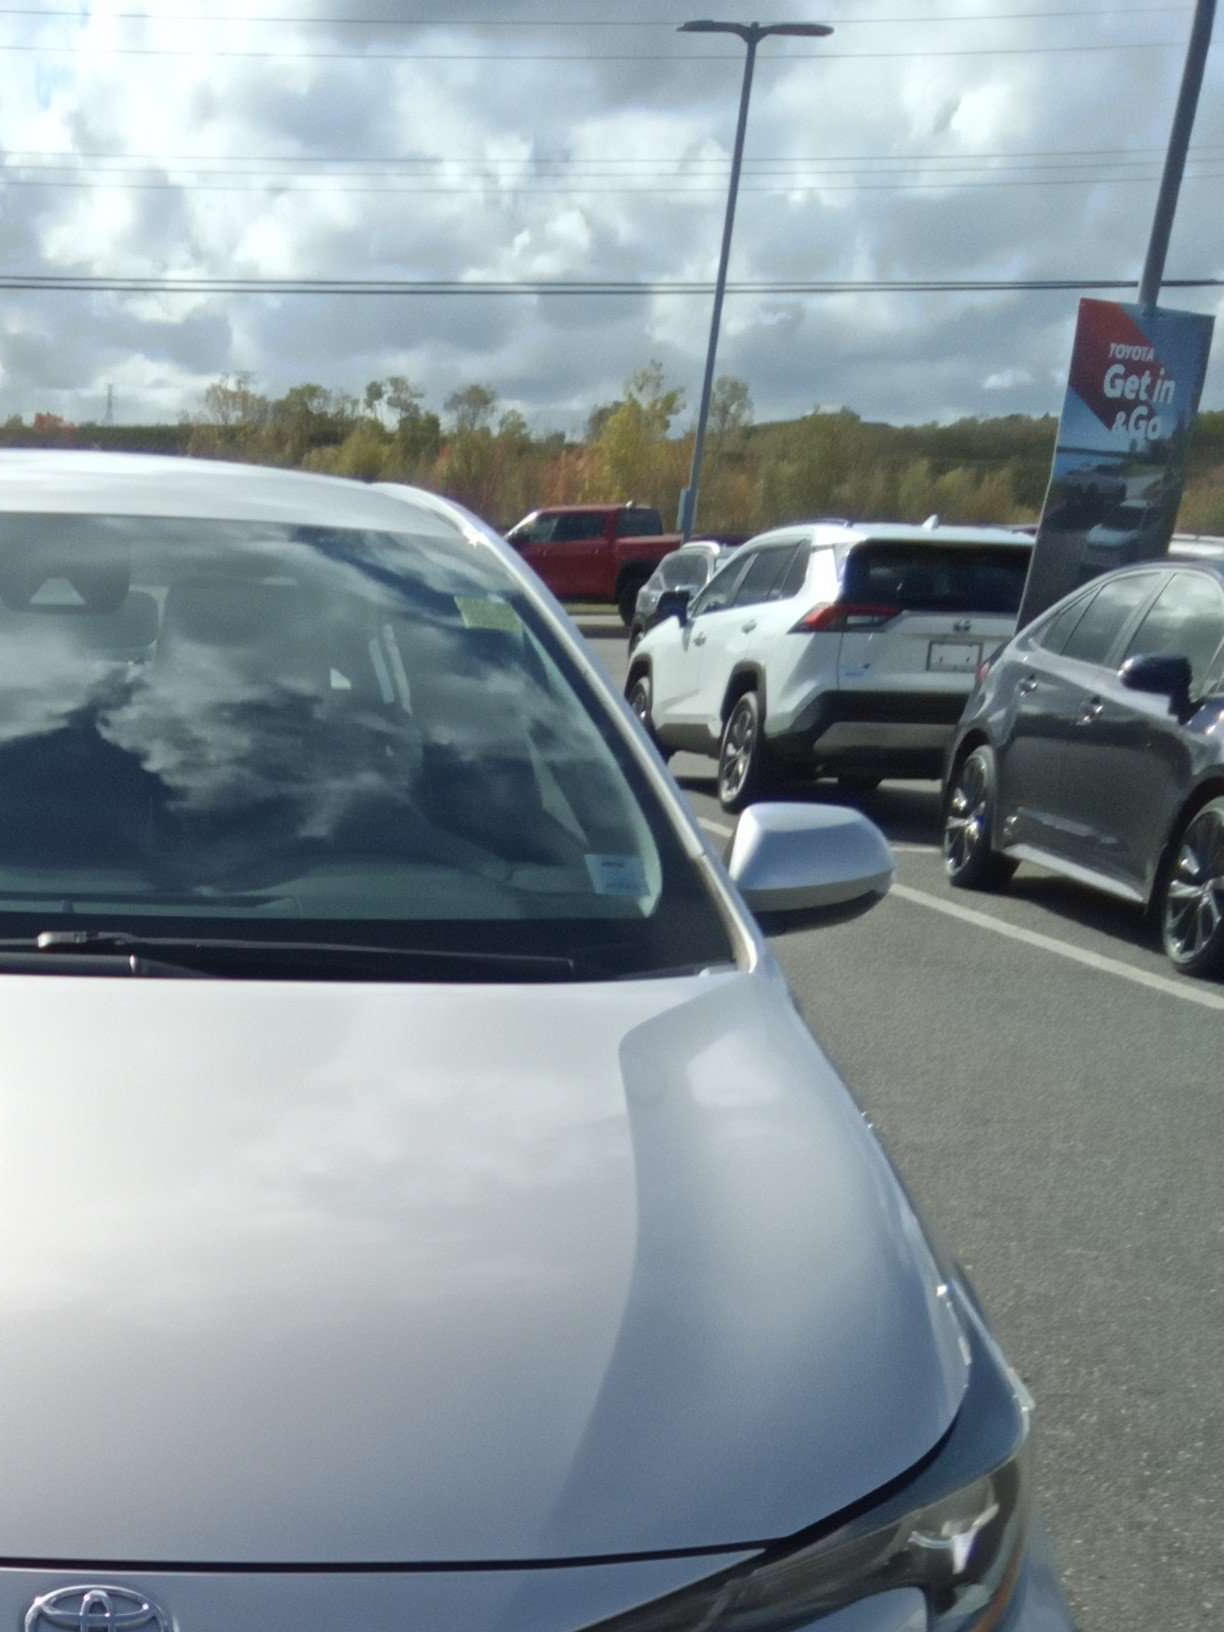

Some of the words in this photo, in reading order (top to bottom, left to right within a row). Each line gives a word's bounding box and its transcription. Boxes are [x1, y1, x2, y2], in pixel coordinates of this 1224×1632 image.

[1109, 342, 1155, 361] TOYOTA
[1103, 363, 1151, 401] Get
[1153, 367, 1176, 404] in
